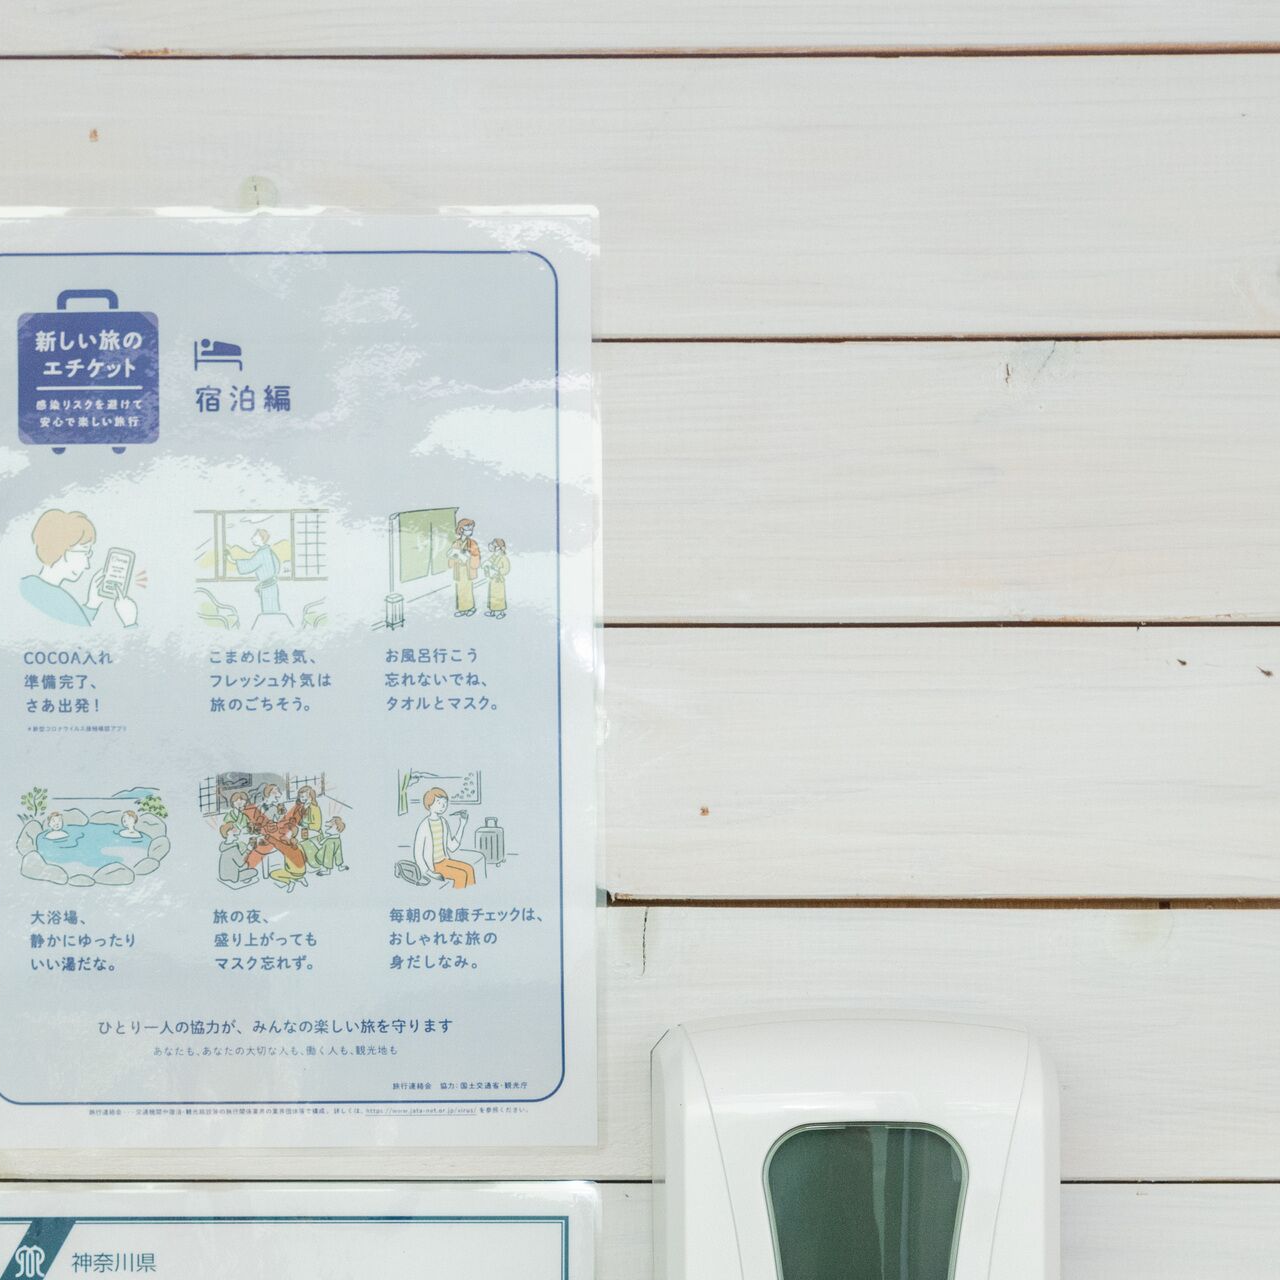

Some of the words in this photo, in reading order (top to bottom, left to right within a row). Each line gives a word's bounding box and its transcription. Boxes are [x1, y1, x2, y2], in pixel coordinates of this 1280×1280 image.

[34, 329, 143, 353] 新しい旅の
[42, 356, 137, 378] エチケット
[35, 398, 143, 411] 感染リスクを避けて
[195, 384, 292, 413] 宿泊編
[39, 415, 140, 428] 安心で楽しい旅行
[23, 650, 114, 665] COCOA入れ
[209, 648, 317, 665] こまめに換気、
[385, 648, 478, 664] お風呂行こう
[23, 674, 97, 690] 準備完了、
[210, 673, 332, 689] フレッシュ外気は
[384, 672, 488, 688] 忘れないでね、
[25, 698, 100, 714] さあ出発！
[210, 697, 311, 713] 旅のごちそう。
[386, 696, 499, 712] タオルとマスク。
[30, 909, 88, 926] 大浴場、
[212, 909, 269, 925] 旅の夜、
[389, 907, 543, 923] 毎朝の健康チェックは、
[29, 933, 136, 948] 静かにゆったり
[214, 931, 318, 948] 盛り上がっても
[389, 930, 498, 946] おしゃれな旅の
[30, 956, 116, 972] いい湯だな。
[215, 955, 315, 971] マスク忘れず。
[390, 954, 480, 970] 身だしなみ。
[98, 1018, 453, 1035] ひとり一人の協力が、みんなの楽しい旅を守ります
[71, 1252, 157, 1273] 神奈川県
